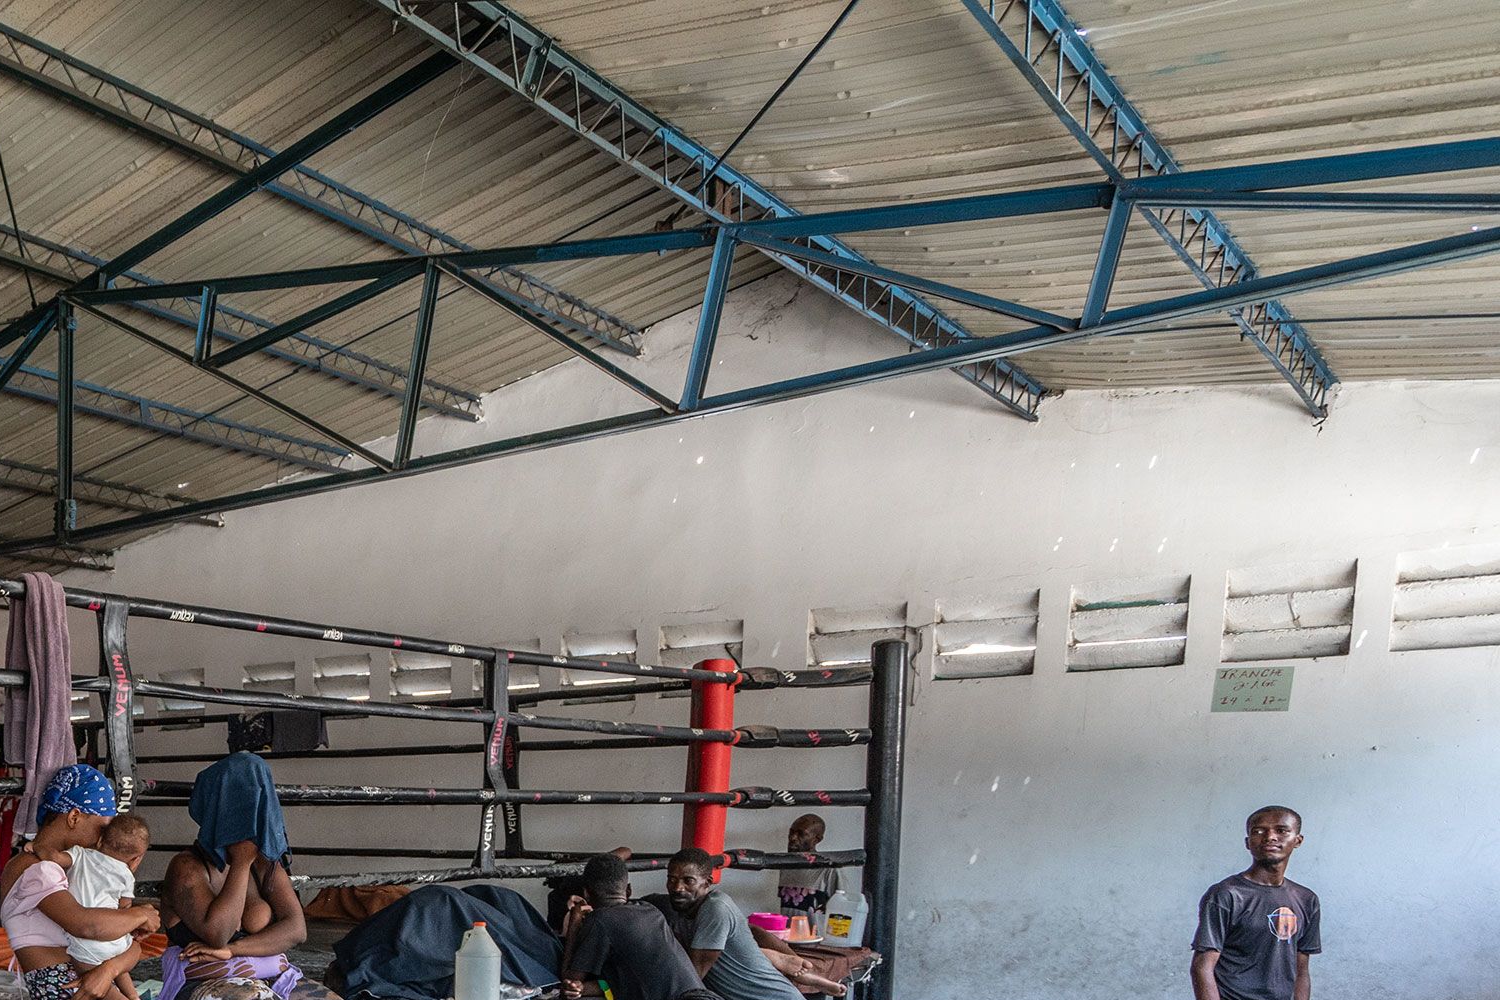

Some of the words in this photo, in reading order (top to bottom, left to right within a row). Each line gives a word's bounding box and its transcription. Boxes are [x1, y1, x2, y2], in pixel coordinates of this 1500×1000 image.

[112, 654, 132, 717] VENUM
[1220, 668, 1284, 680] TRANCHE
[490, 717, 505, 766] VENUM
[117, 776, 133, 813] NUM
[483, 804, 495, 851] VENUM
[509, 801, 518, 835] VENUM
